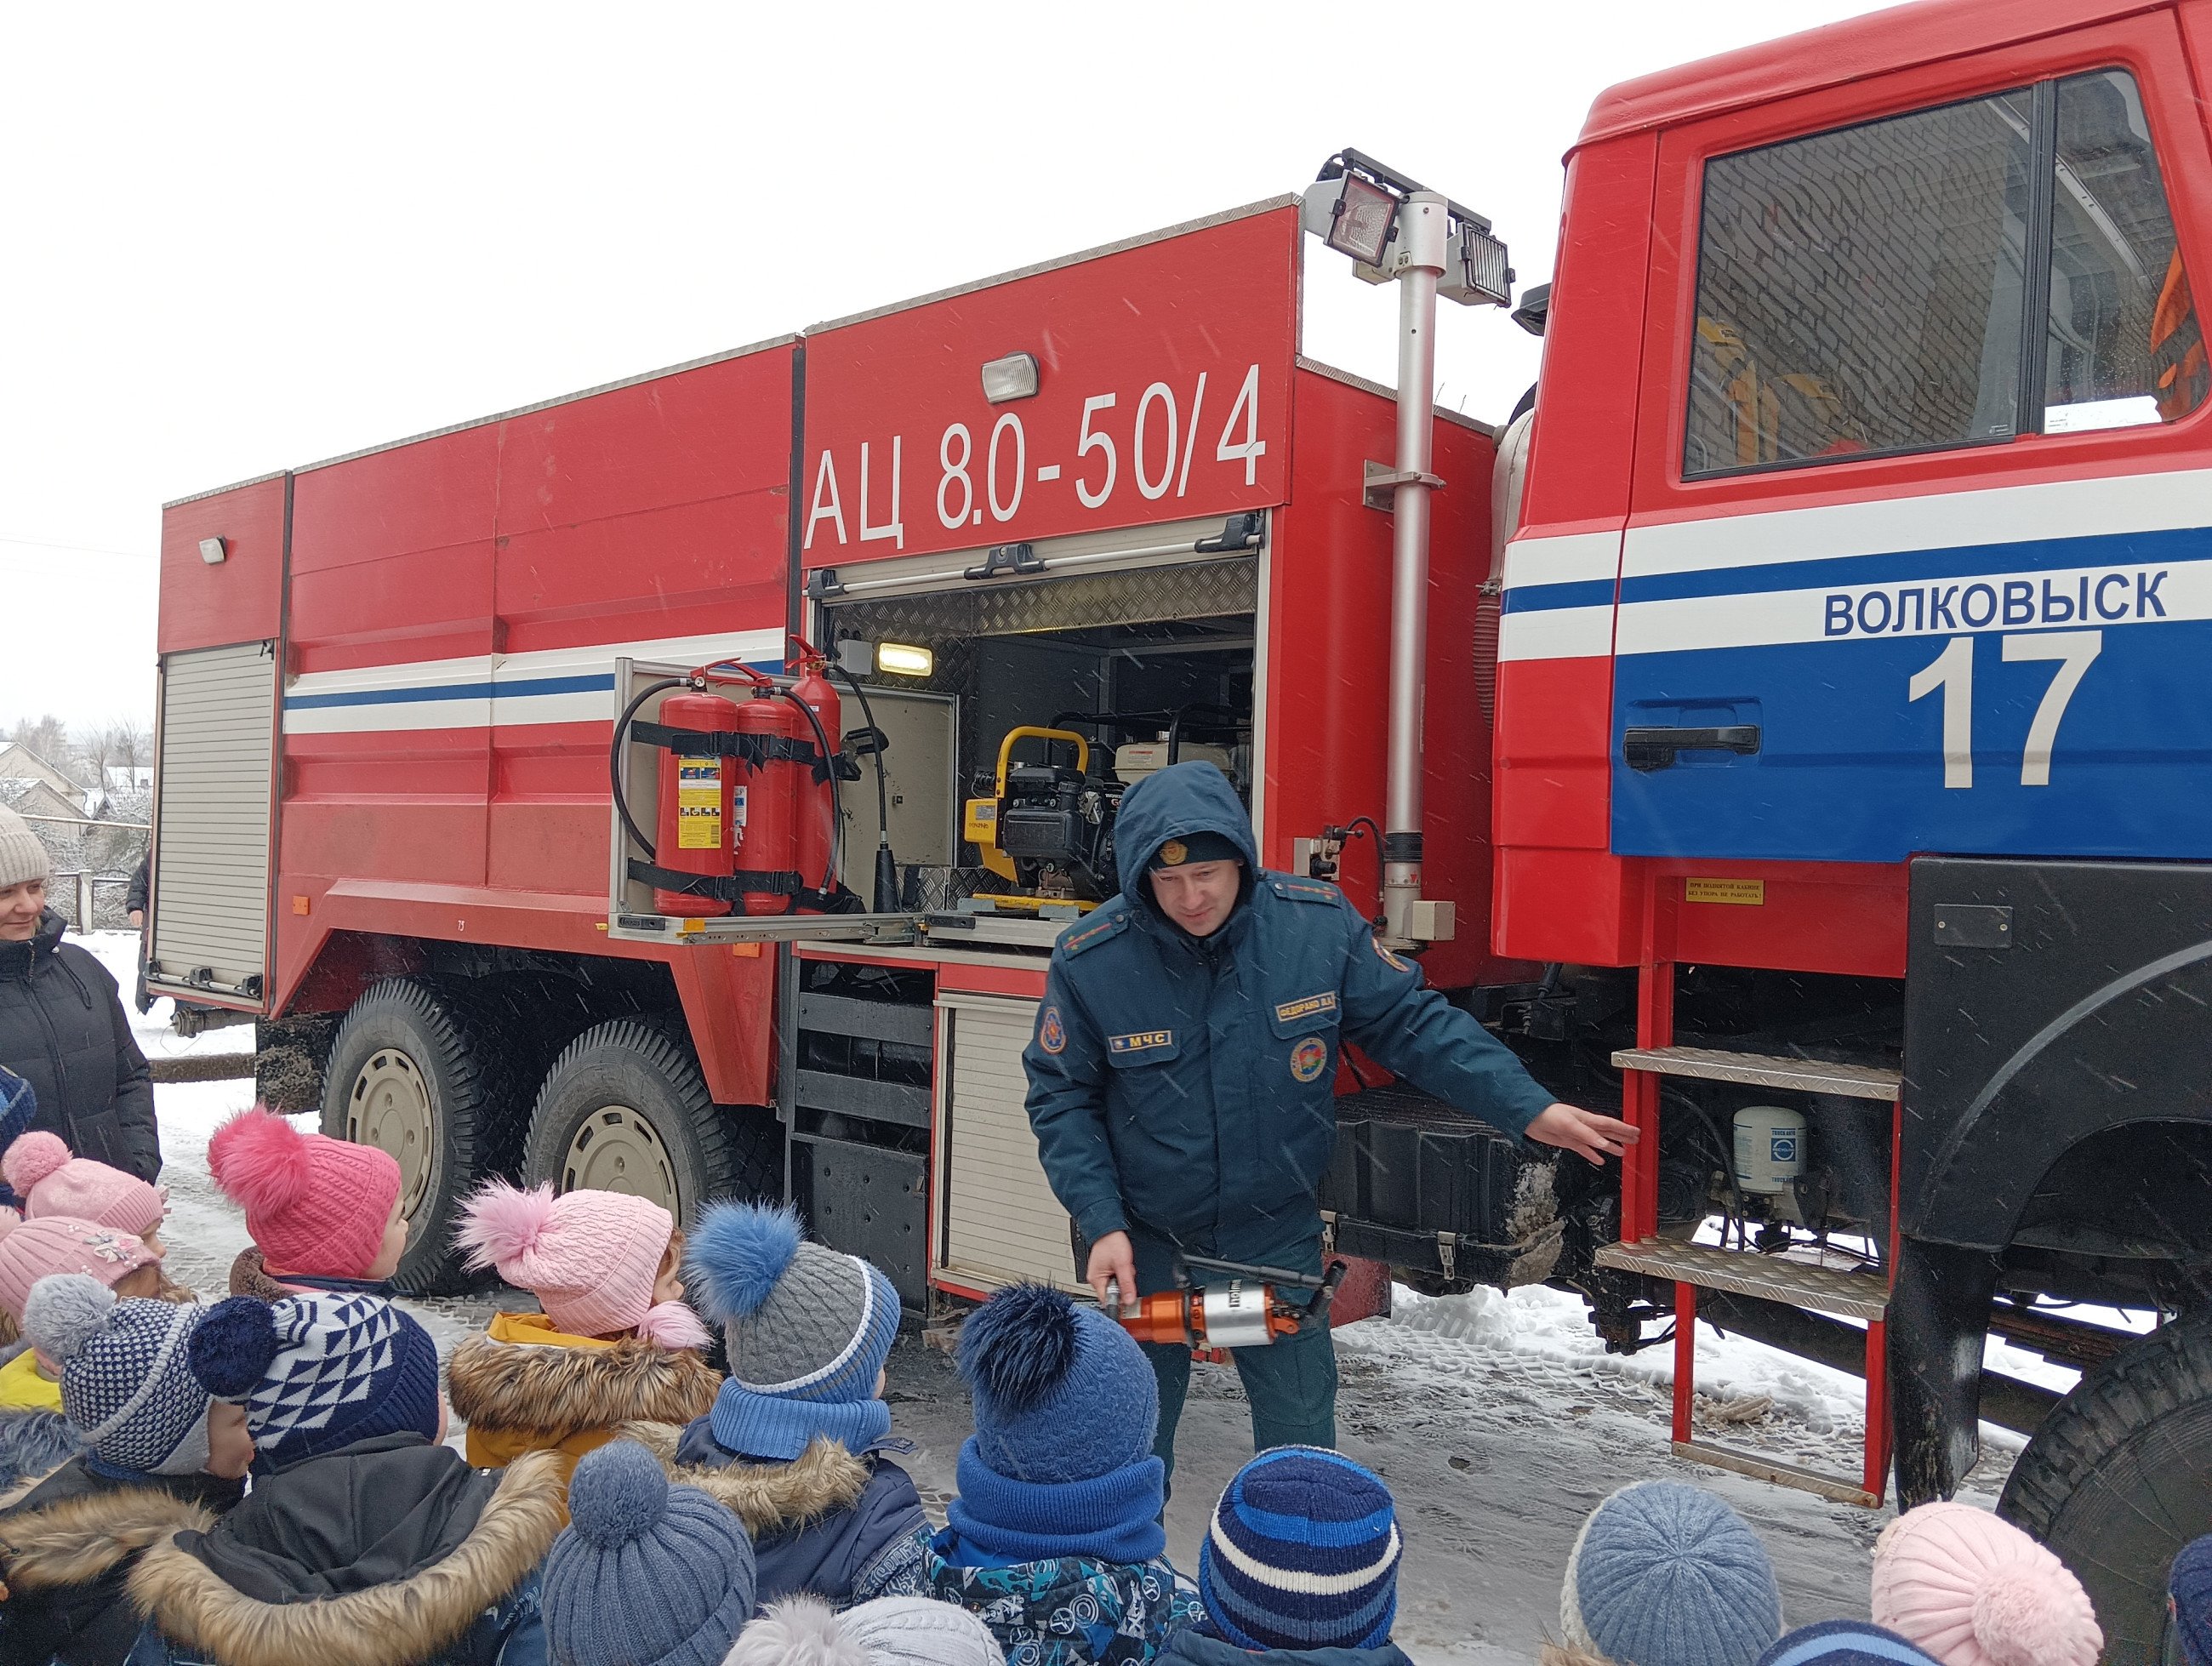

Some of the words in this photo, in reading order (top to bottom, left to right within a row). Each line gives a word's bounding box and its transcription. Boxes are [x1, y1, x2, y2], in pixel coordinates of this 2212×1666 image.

[803, 435, 904, 550] АЦ
[936, 363, 1266, 529] 8.0-50/4
[1824, 571, 2168, 636] ВОЛКОВЫСК
[1908, 630, 2102, 789] 17
[1129, 1033, 1165, 1047] МЧС
